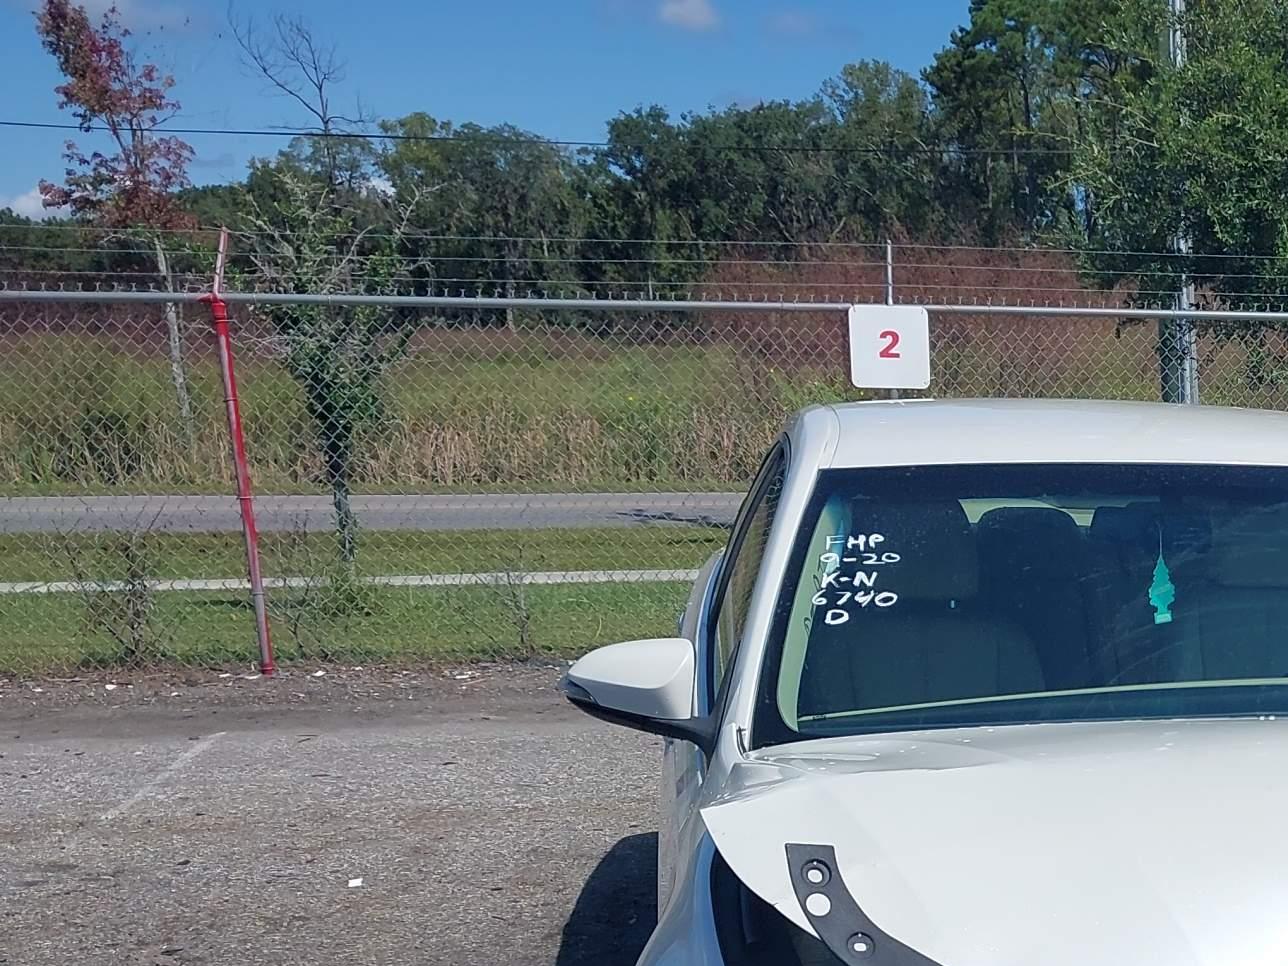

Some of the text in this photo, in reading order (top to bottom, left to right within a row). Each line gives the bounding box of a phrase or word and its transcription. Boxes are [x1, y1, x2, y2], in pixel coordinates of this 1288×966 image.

[879, 330, 901, 359] 2
[825, 533, 885, 551] FHP
[820, 552, 901, 568] 9-20
[820, 571, 878, 589] K-N
[811, 589, 898, 608] 6740
